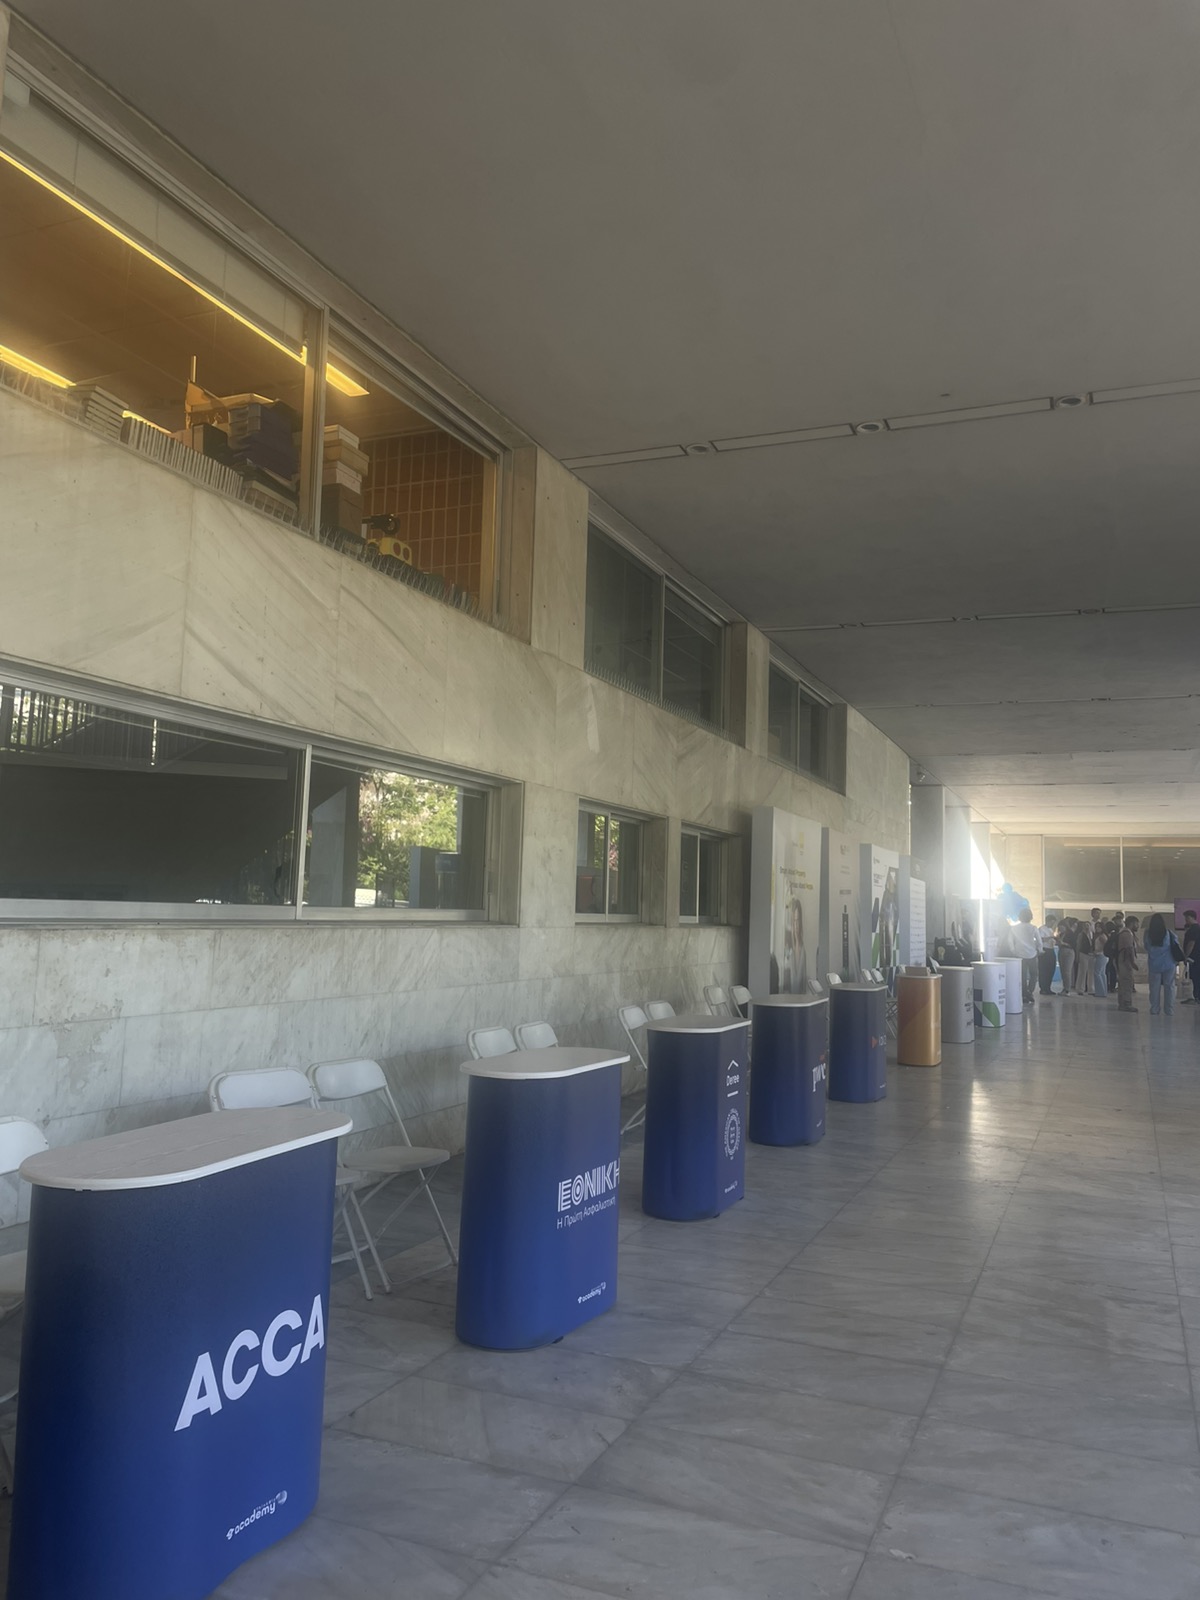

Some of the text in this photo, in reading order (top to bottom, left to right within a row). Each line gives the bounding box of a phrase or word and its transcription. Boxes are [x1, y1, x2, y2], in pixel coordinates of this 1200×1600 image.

[556, 1217, 563, 1229] Η
[174, 1293, 325, 1432] ACCA
[235, 1501, 276, 1535] academy
